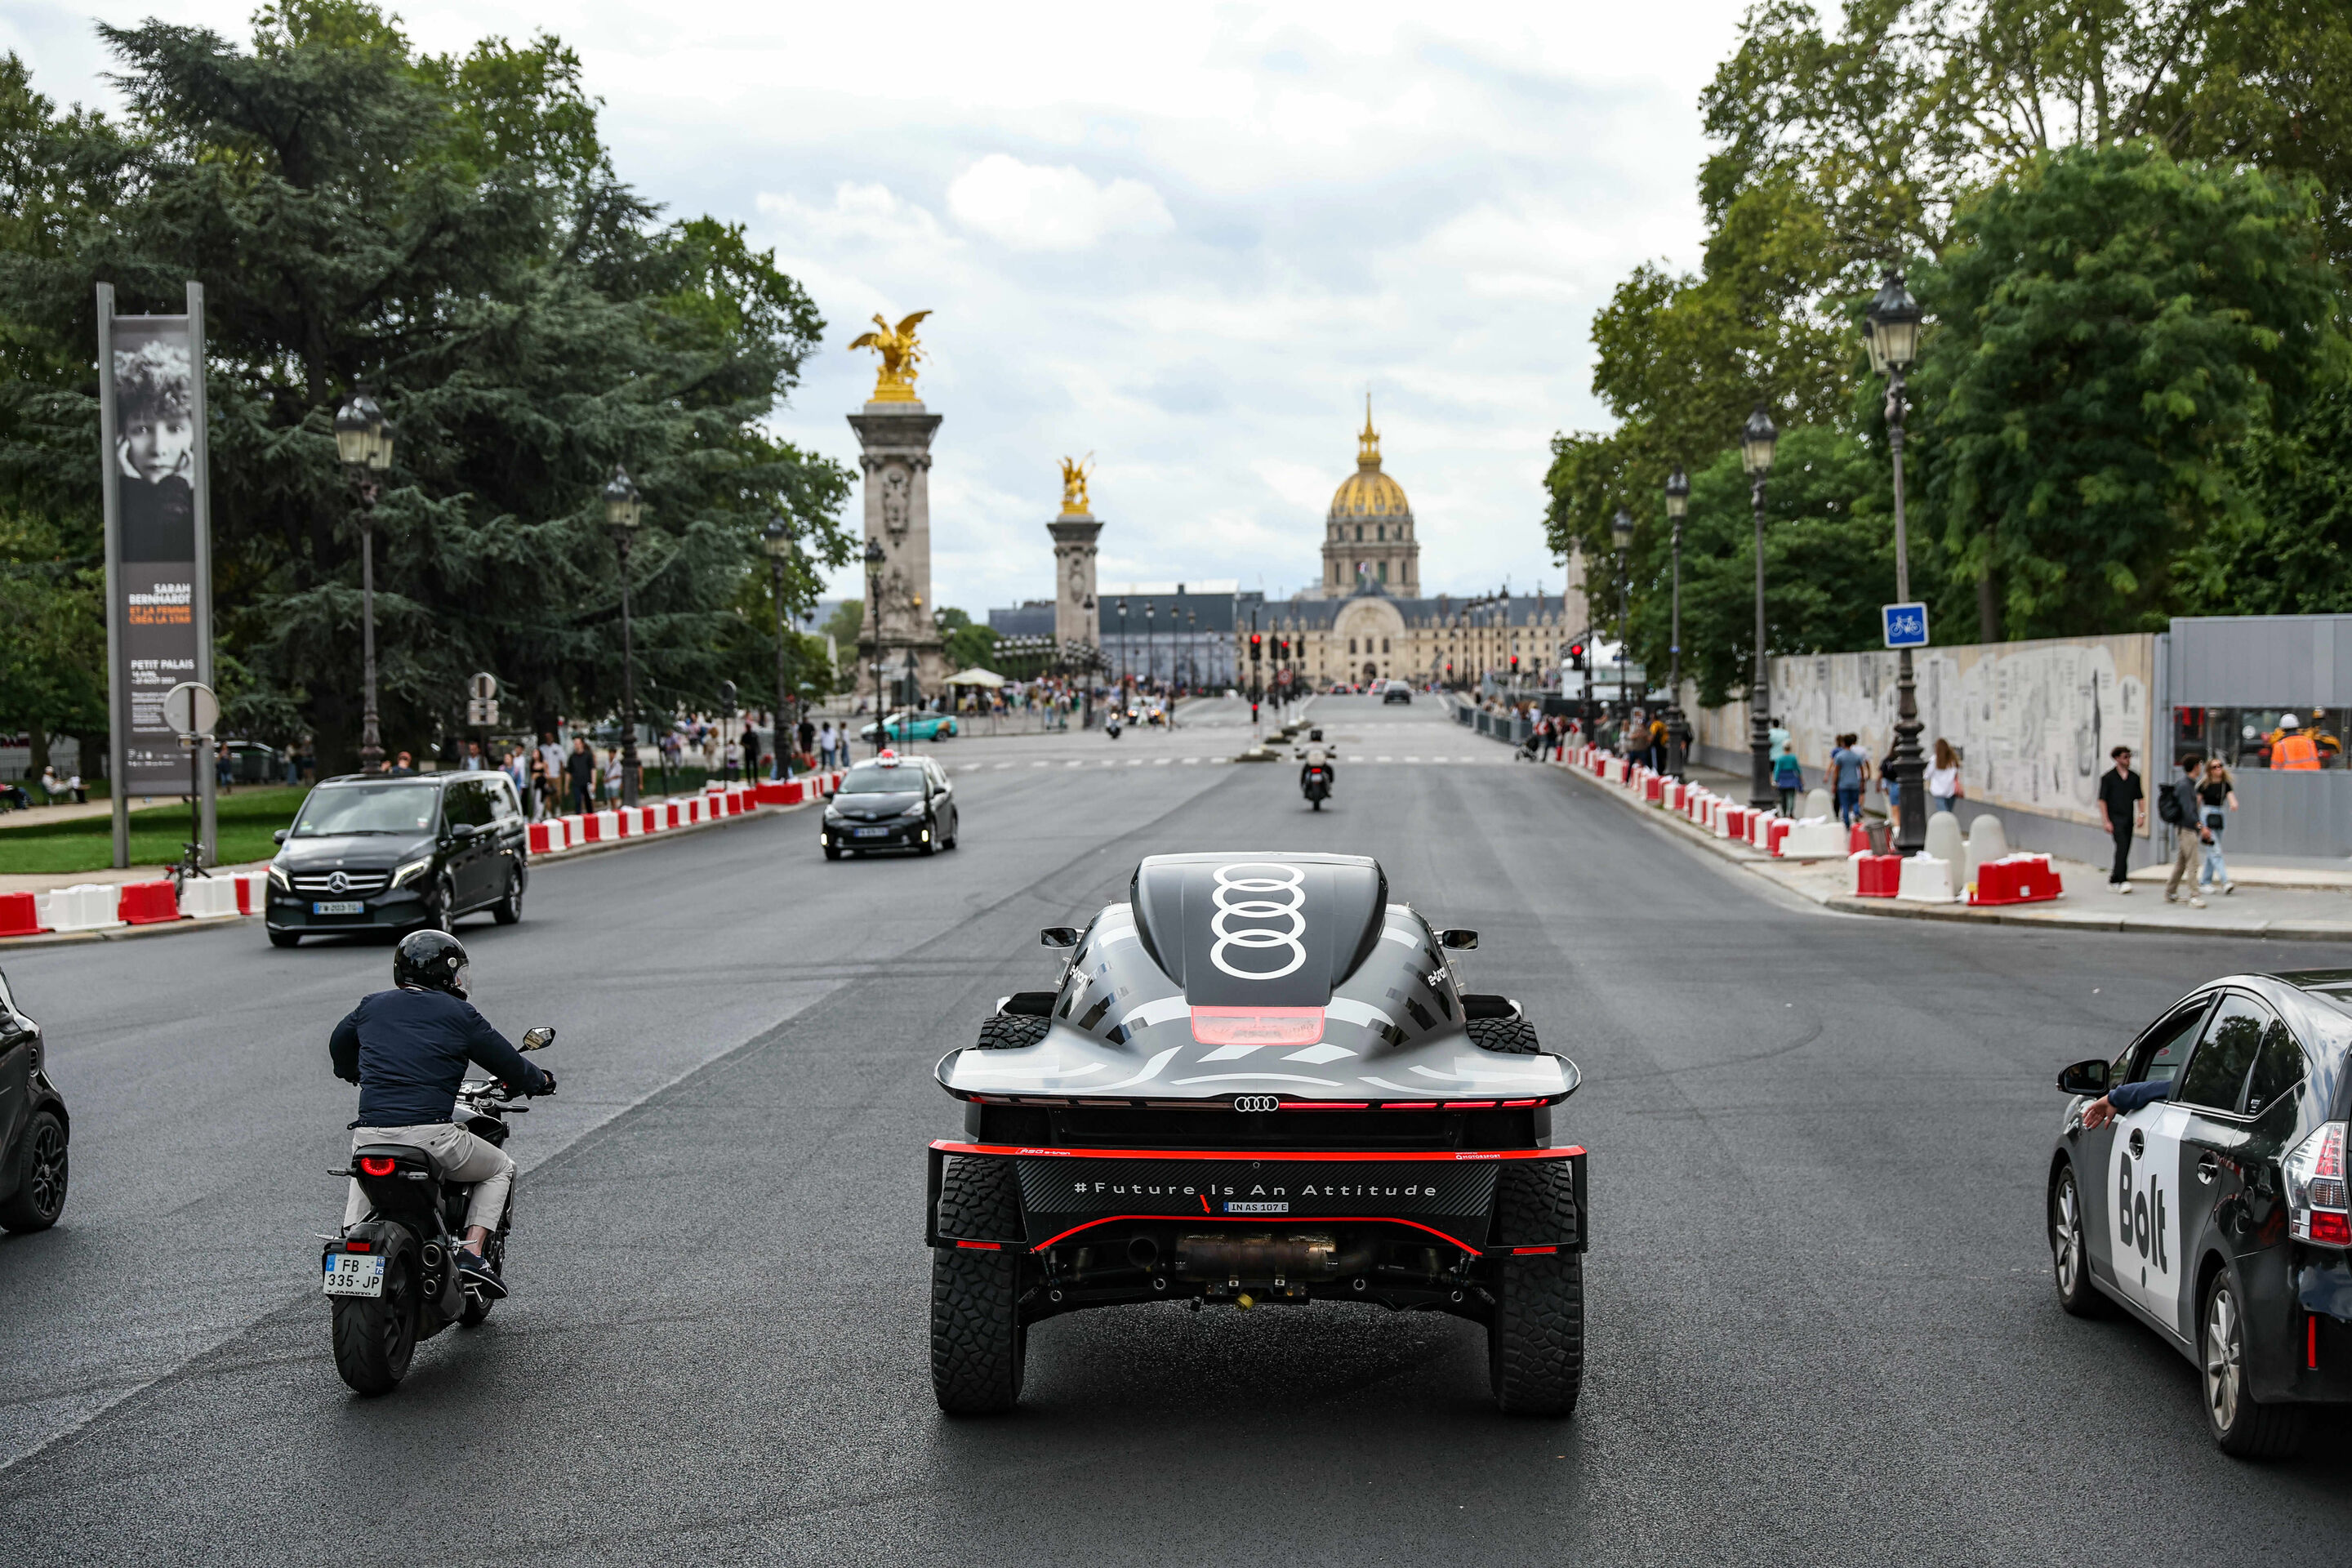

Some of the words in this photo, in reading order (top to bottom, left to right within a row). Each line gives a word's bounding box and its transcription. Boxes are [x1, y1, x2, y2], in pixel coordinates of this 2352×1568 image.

[154, 583, 191, 594] SARAH
[129, 594, 191, 604] BERNHARDT
[131, 660, 158, 670] PETIT
[160, 659, 195, 670] PALAIS
[1074, 1183, 1195, 1195] #Future
[1211, 1184, 1234, 1195] Is
[1250, 1184, 1285, 1196] An
[1302, 1185, 1437, 1196] Attitude
[2119, 1152, 2167, 1288] Bolt
[376, 1266, 384, 1274] 75
